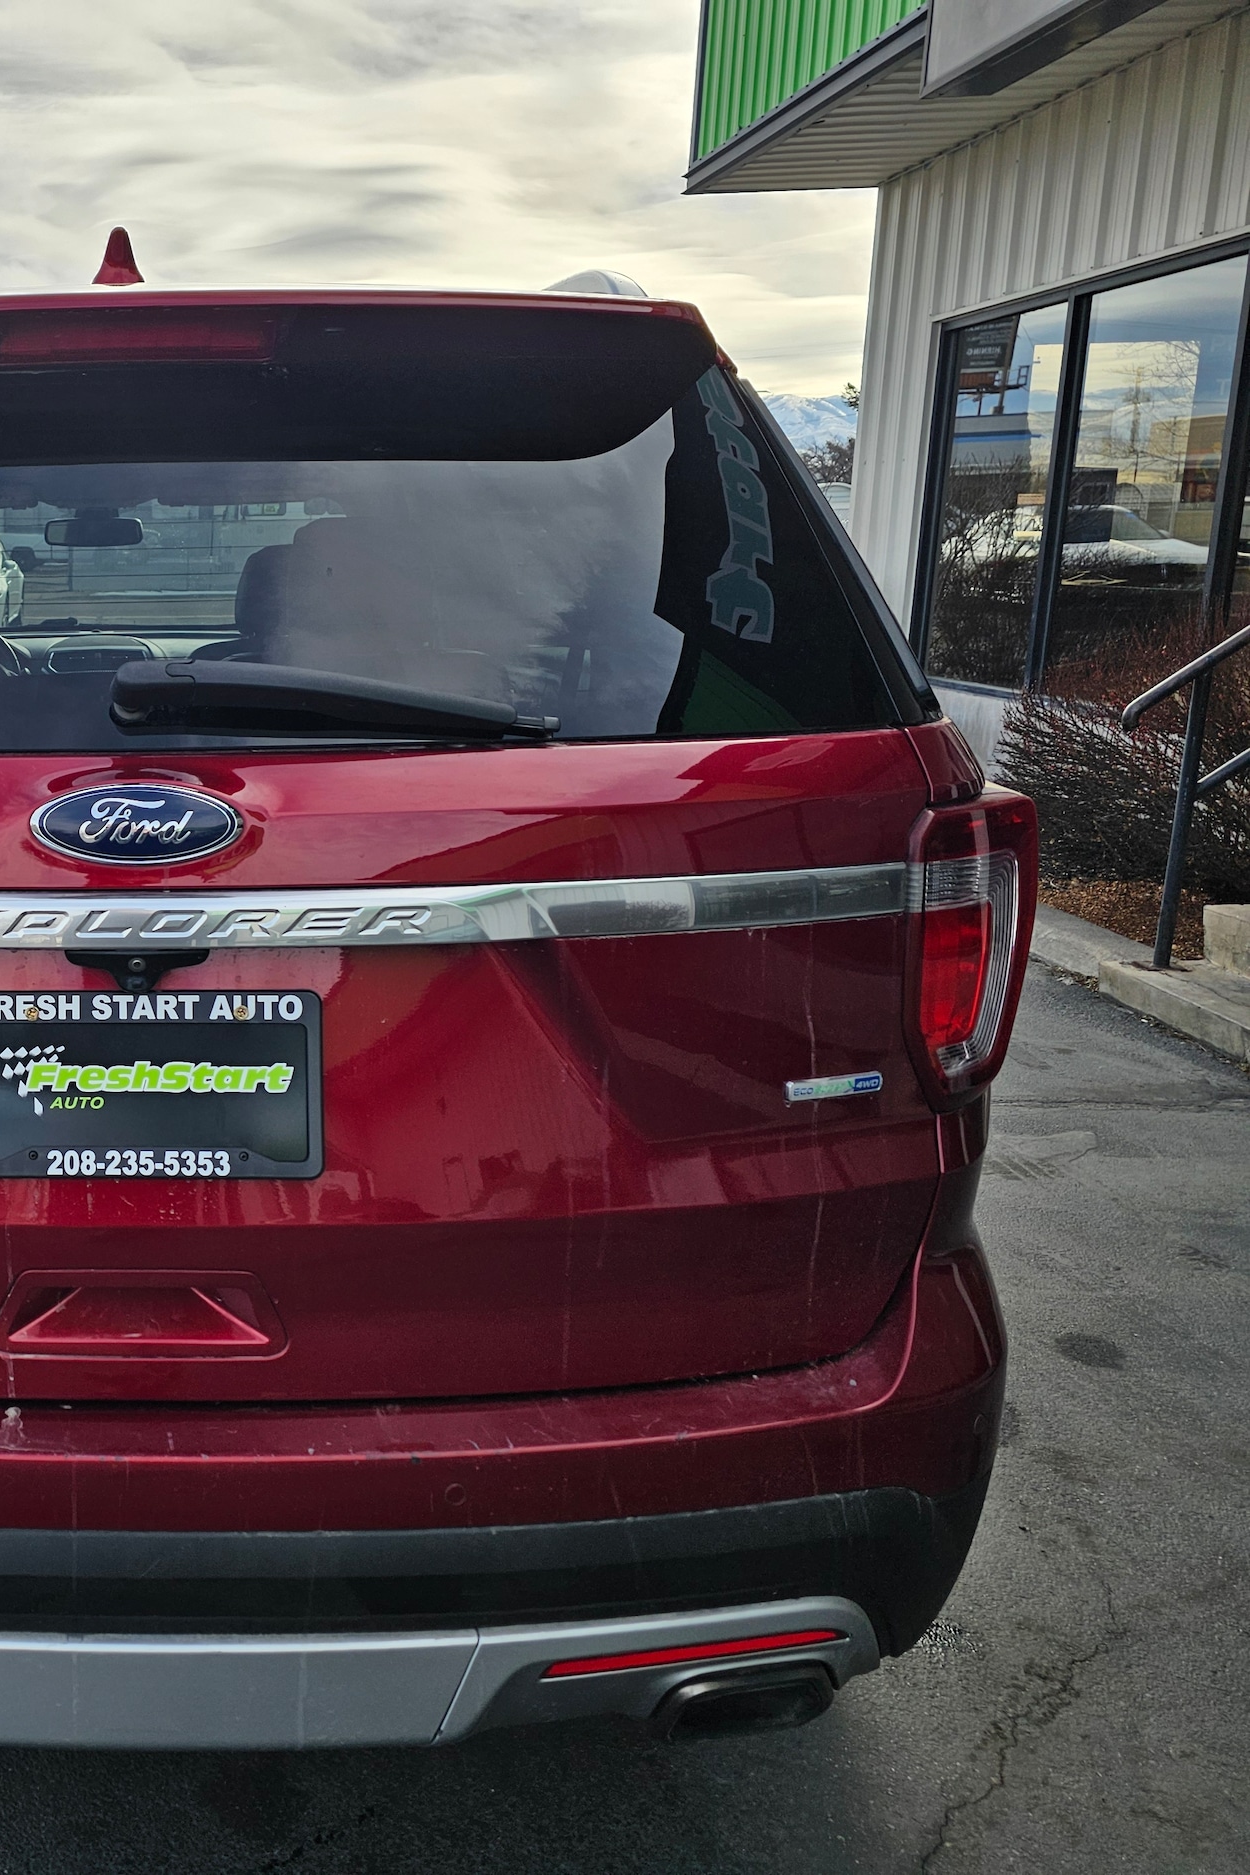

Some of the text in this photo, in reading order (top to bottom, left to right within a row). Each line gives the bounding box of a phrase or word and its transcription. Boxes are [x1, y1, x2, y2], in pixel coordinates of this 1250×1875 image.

[78, 797, 194, 844] Ford
[91, 995, 200, 1021] START
[209, 995, 304, 1021] AUTO
[26, 1061, 294, 1094] FreshStart
[855, 1078, 879, 1089] 4WD
[50, 1097, 105, 1110] AUTO
[46, 1150, 232, 1177] 208-235-5353
